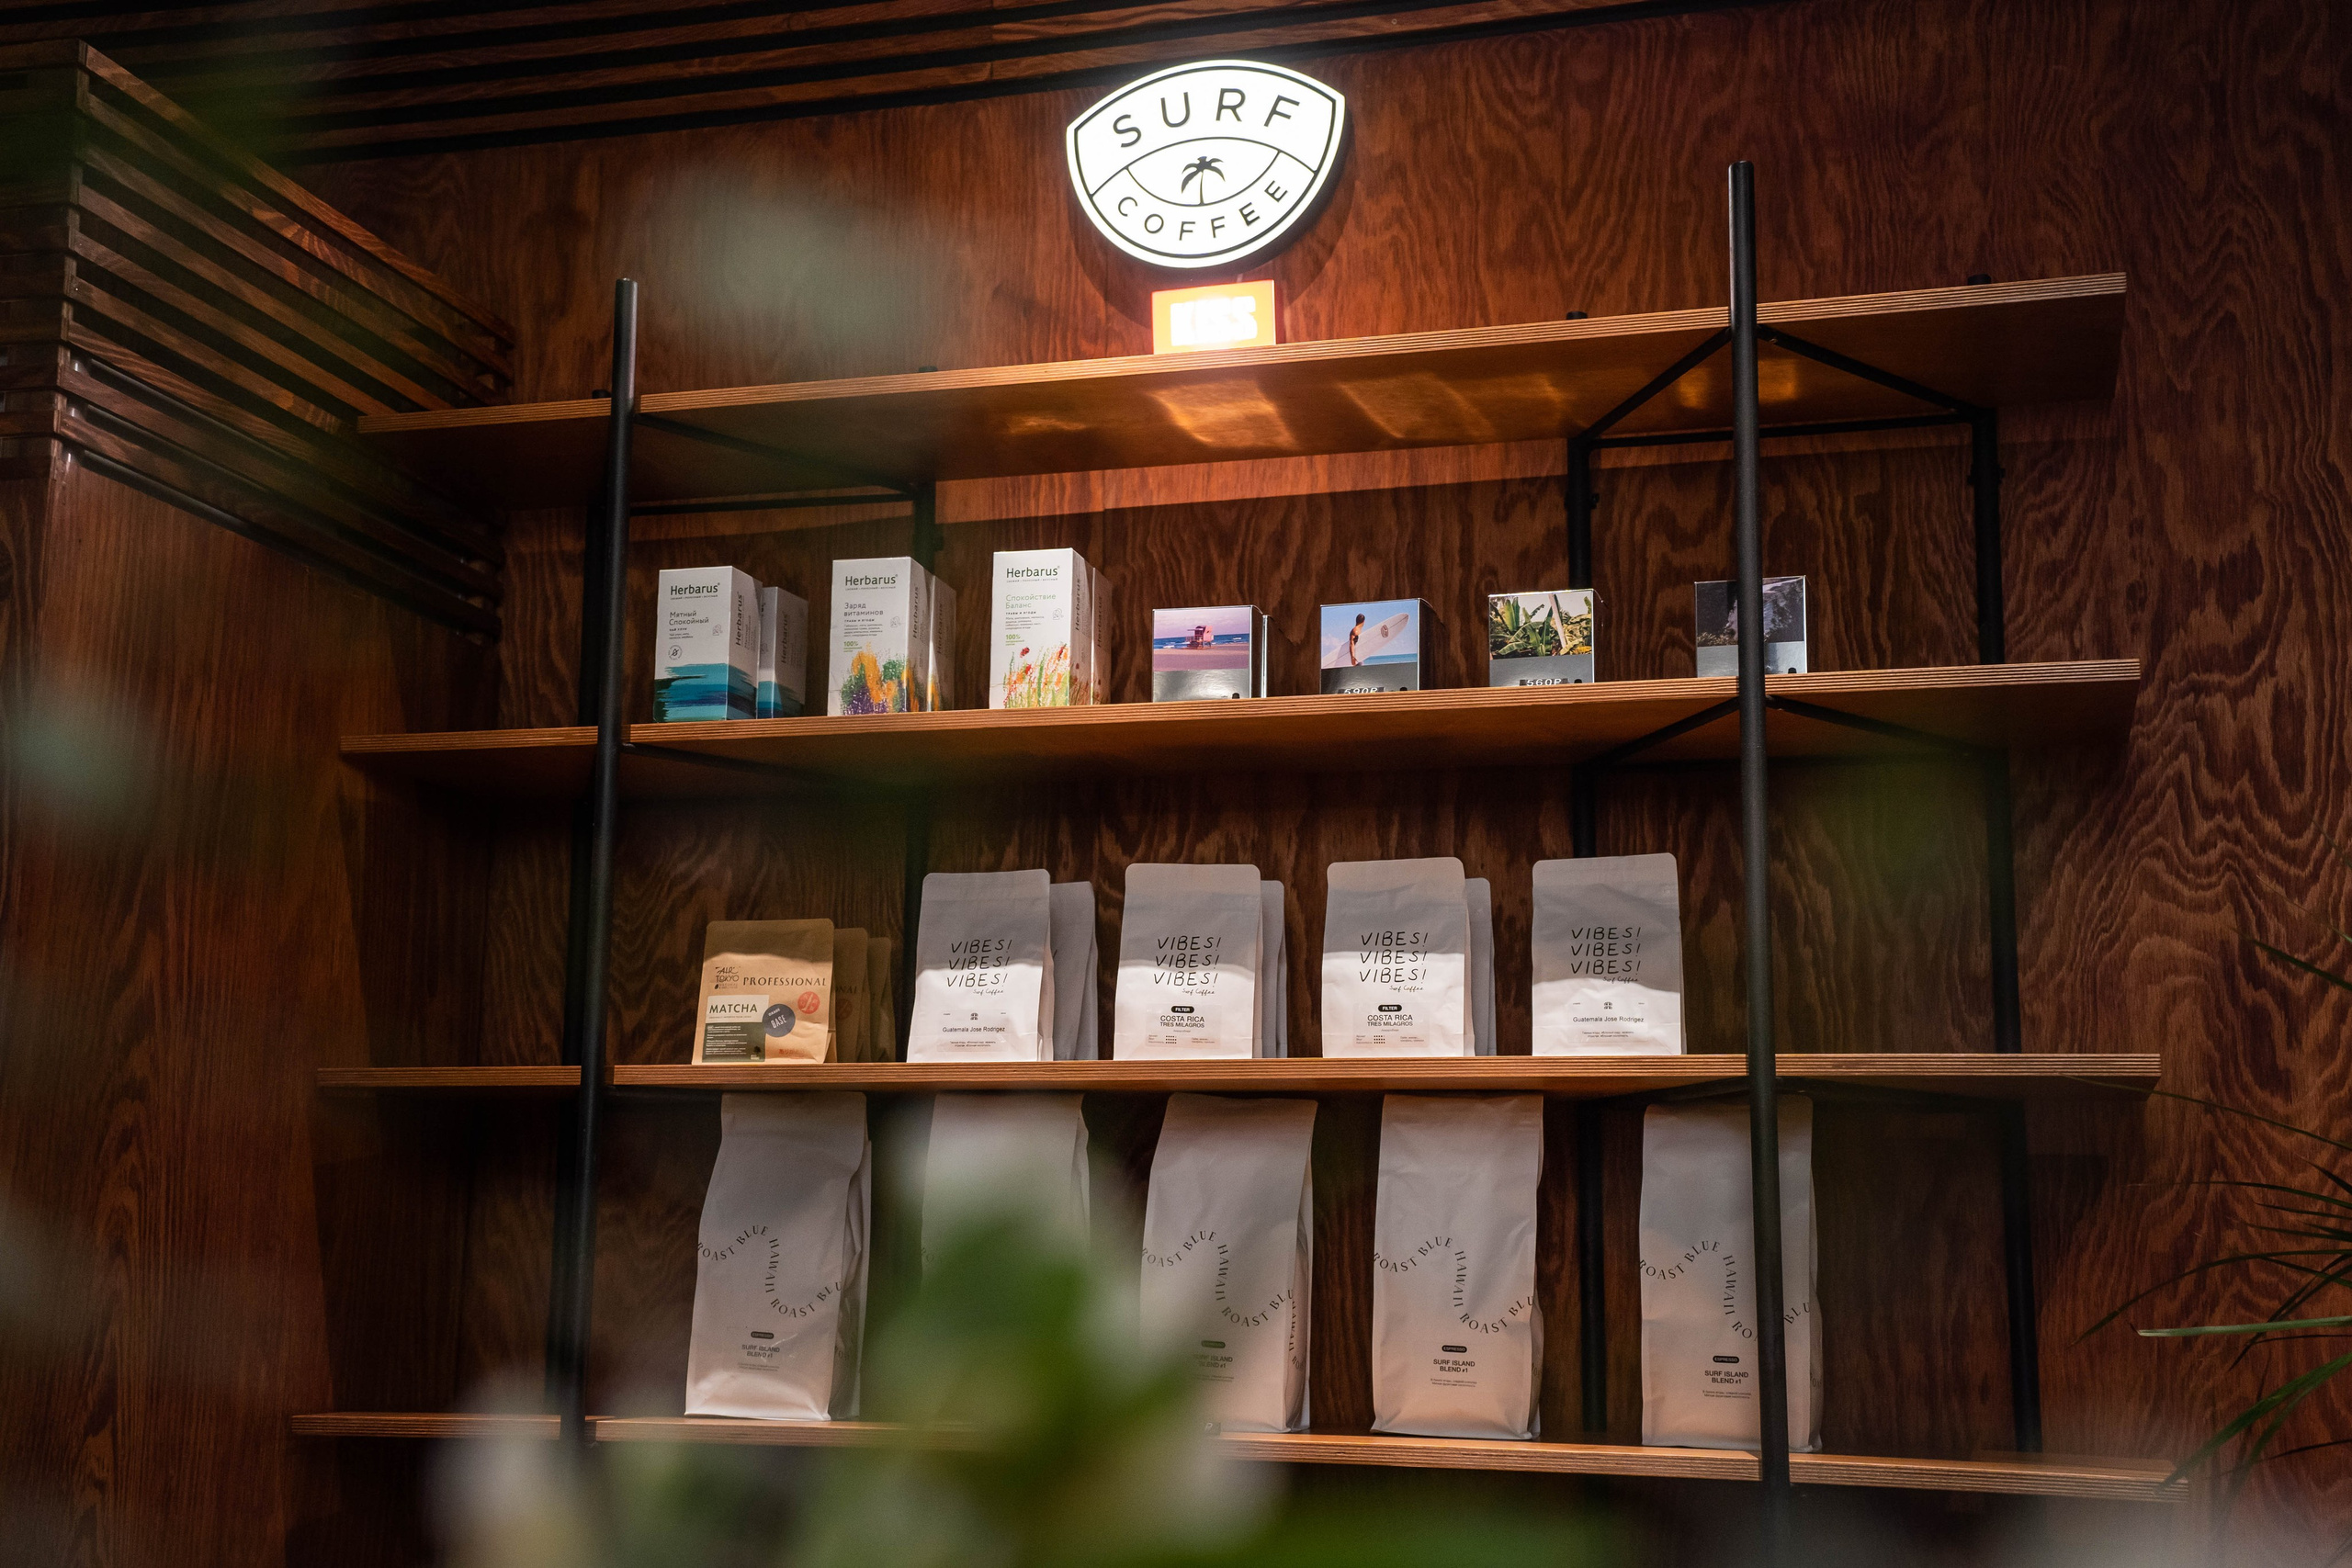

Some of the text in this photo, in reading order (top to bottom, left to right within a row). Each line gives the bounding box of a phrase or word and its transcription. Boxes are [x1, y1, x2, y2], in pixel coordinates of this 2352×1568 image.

[1113, 87, 1300, 148] SURF
[1117, 180, 1288, 242] COFFEE
[845, 575, 896, 586] Herbarus
[1006, 567, 1058, 579] Herbarus
[670, 584, 718, 596] Herbarus
[1005, 593, 1057, 602] Спокойствие
[669, 617, 709, 626] Спокойный
[670, 610, 697, 618] Мятный
[735, 594, 743, 646] Herbarus
[1361, 931, 1429, 947] VIBES!
[1571, 926, 1642, 941] VIBES!
[951, 939, 1012, 953] VIBES!
[1157, 935, 1221, 951] VIBES!
[1570, 942, 1641, 957] VIBES!
[948, 955, 1010, 970] VIBES!
[1155, 953, 1220, 969] VIBES!
[1360, 949, 1428, 965] VIBES!
[1359, 967, 1427, 984] VIBES!
[1570, 959, 1641, 976] VIBES!
[743, 976, 827, 987] PROFESSIONAL
[946, 972, 1008, 987] VIBES!
[1153, 971, 1218, 987] VIBES!
[708, 1003, 758, 1014] MATCHA
[770, 1014, 786, 1029] BASE
[736, 1224, 769, 1246] BLUE
[1182, 1230, 1216, 1251] BLUE
[1418, 1235, 1453, 1257] BLUE
[764, 1238, 780, 1292] HAWAII
[1215, 1244, 1229, 1301] HAWAII
[1453, 1250, 1467, 1307] HAWAII
[1684, 1240, 1721, 1263] BLUE
[1723, 1255, 1737, 1315] HAWAII
[1783, 1302, 1810, 1325] BLU
[816, 1281, 842, 1302] BLU
[1269, 1289, 1294, 1310] BLU
[770, 1298, 815, 1318] ROAST
[1509, 1295, 1533, 1316] BLU
[1221, 1306, 1269, 1327] ROAST
[1459, 1313, 1508, 1334] ROAST
